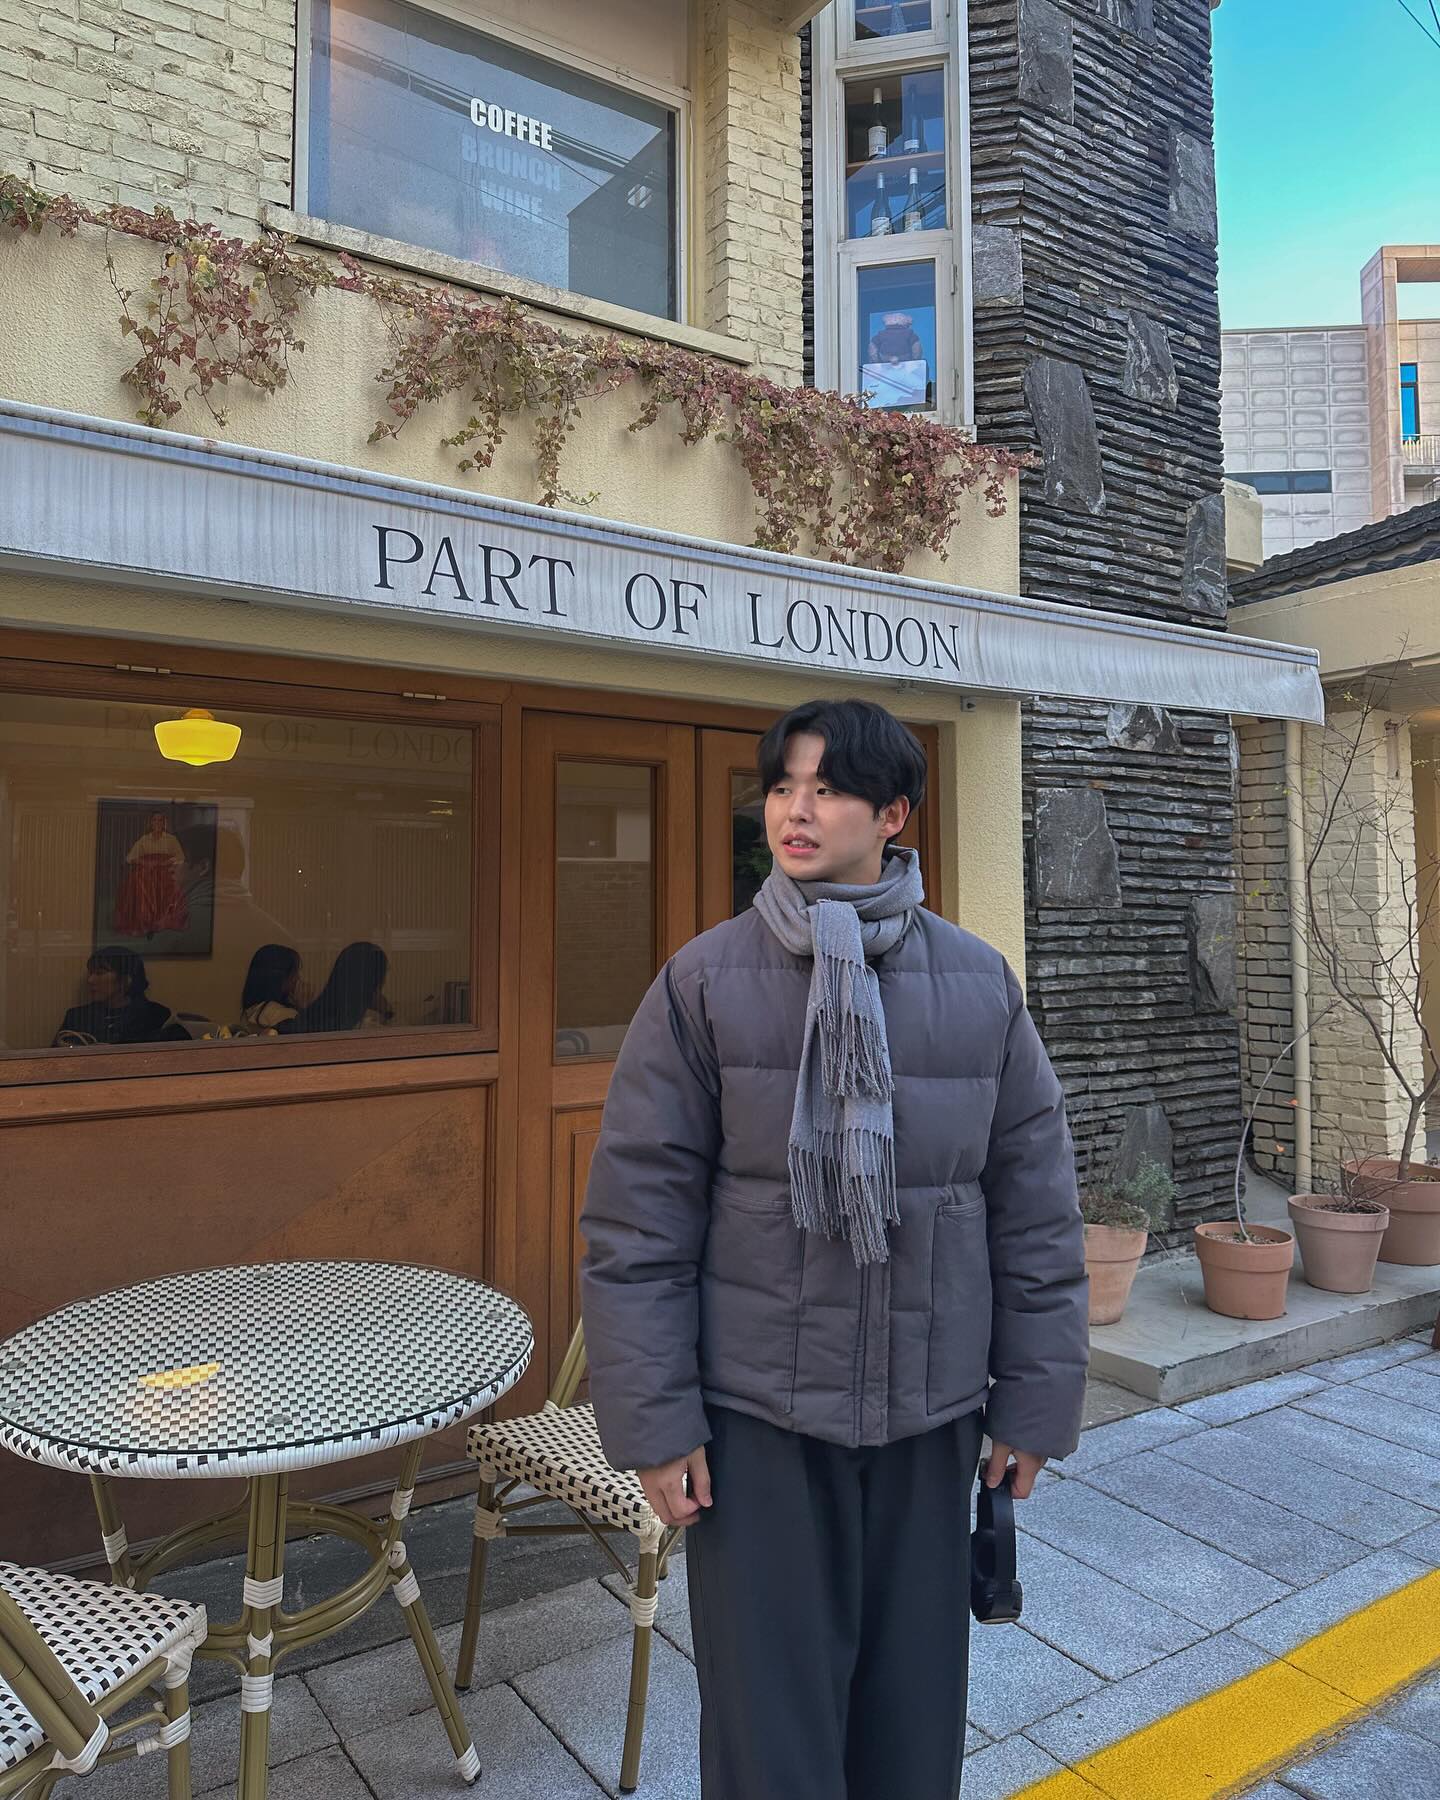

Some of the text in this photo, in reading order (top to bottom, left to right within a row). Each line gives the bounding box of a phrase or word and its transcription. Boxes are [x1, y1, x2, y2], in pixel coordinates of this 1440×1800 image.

[470, 97, 553, 151] COFFEE
[460, 132, 560, 191] BRUNCH
[481, 179, 543, 224] WINE
[372, 525, 960, 671] PART OF LONDON
